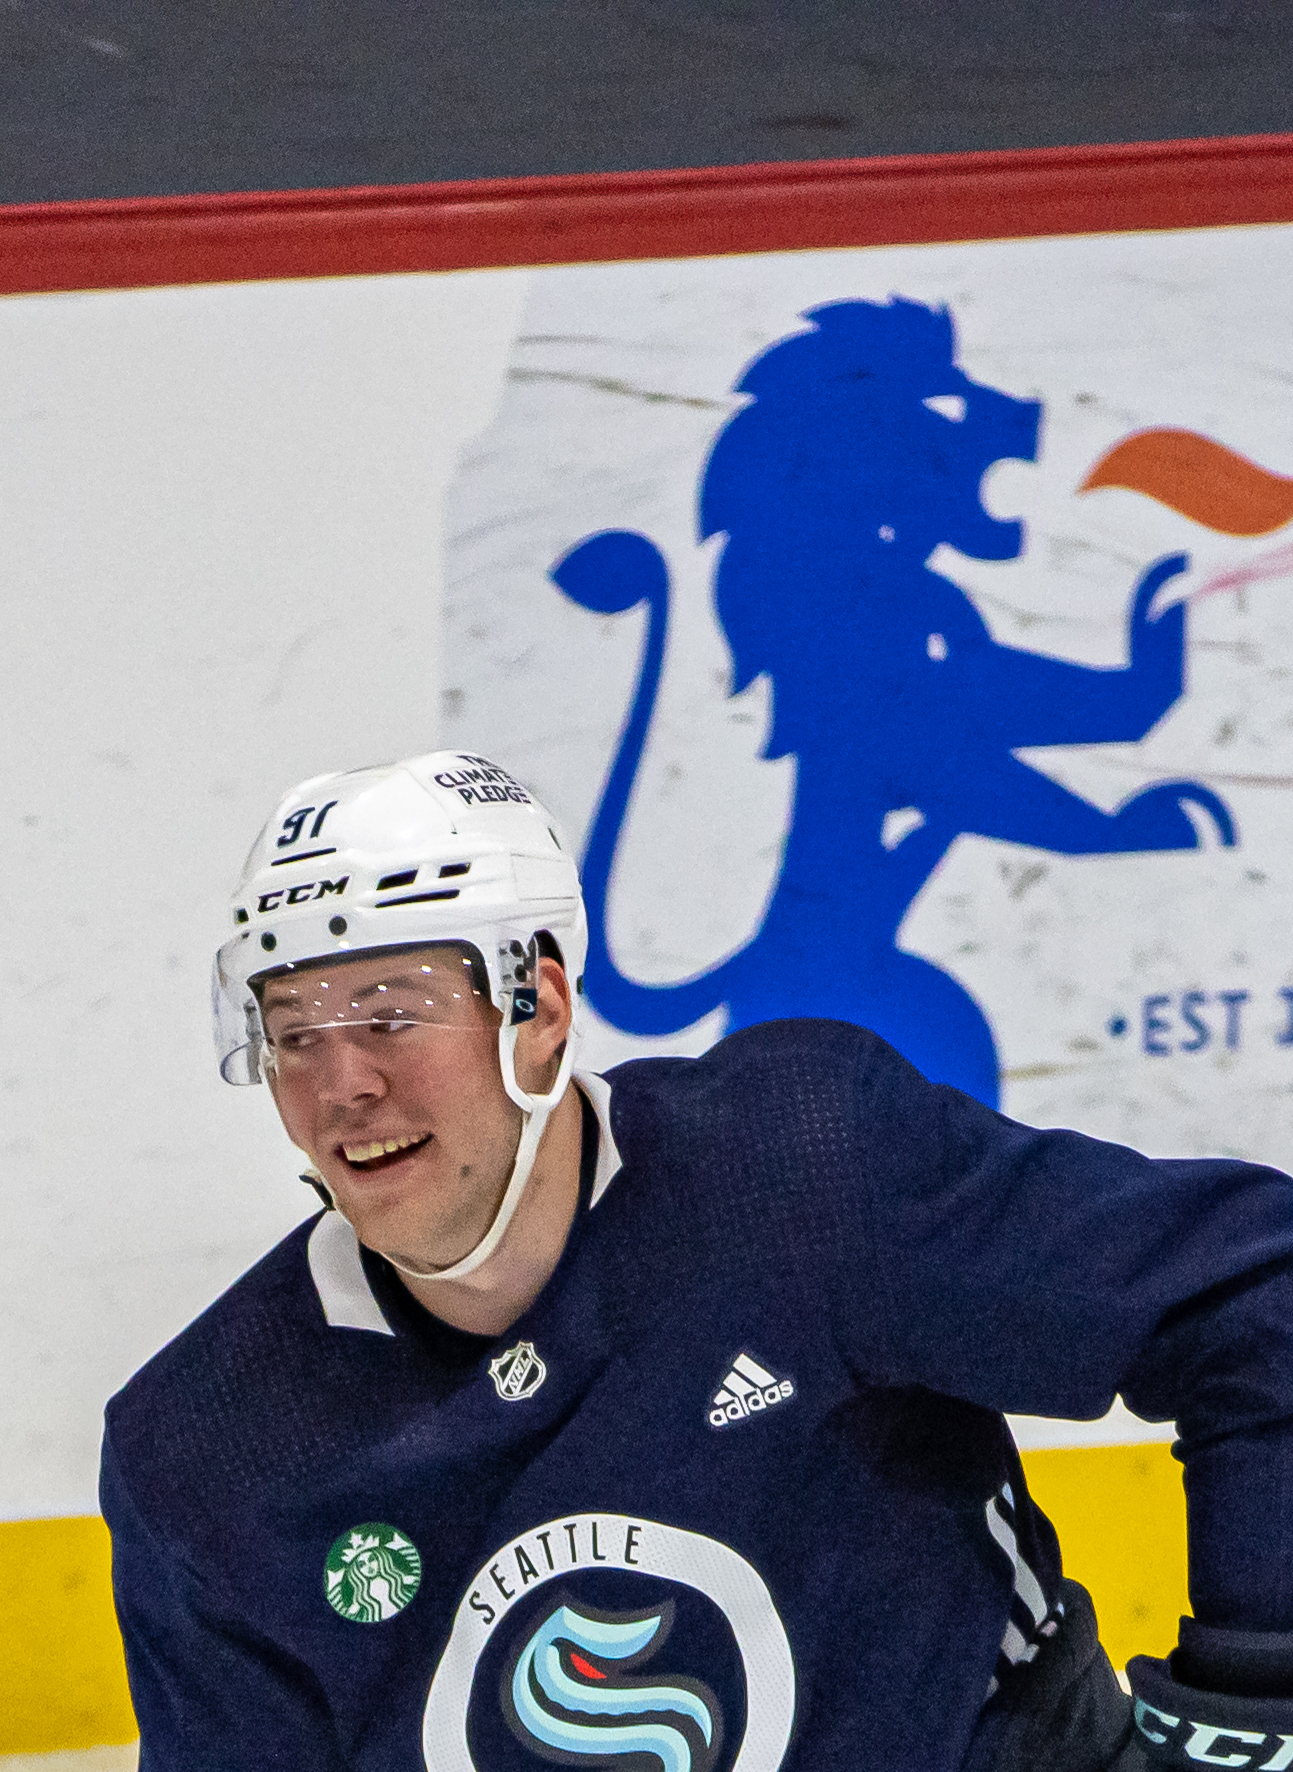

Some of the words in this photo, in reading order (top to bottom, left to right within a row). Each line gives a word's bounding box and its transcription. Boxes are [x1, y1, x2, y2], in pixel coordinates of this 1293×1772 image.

[457, 784, 533, 805] PLEDGE
[276, 800, 339, 849] 91
[256, 874, 351, 914] CCM
[1140, 988, 1252, 1056] EST
[709, 1378, 795, 1427] adidas
[469, 1521, 643, 1625] SEATTLE
